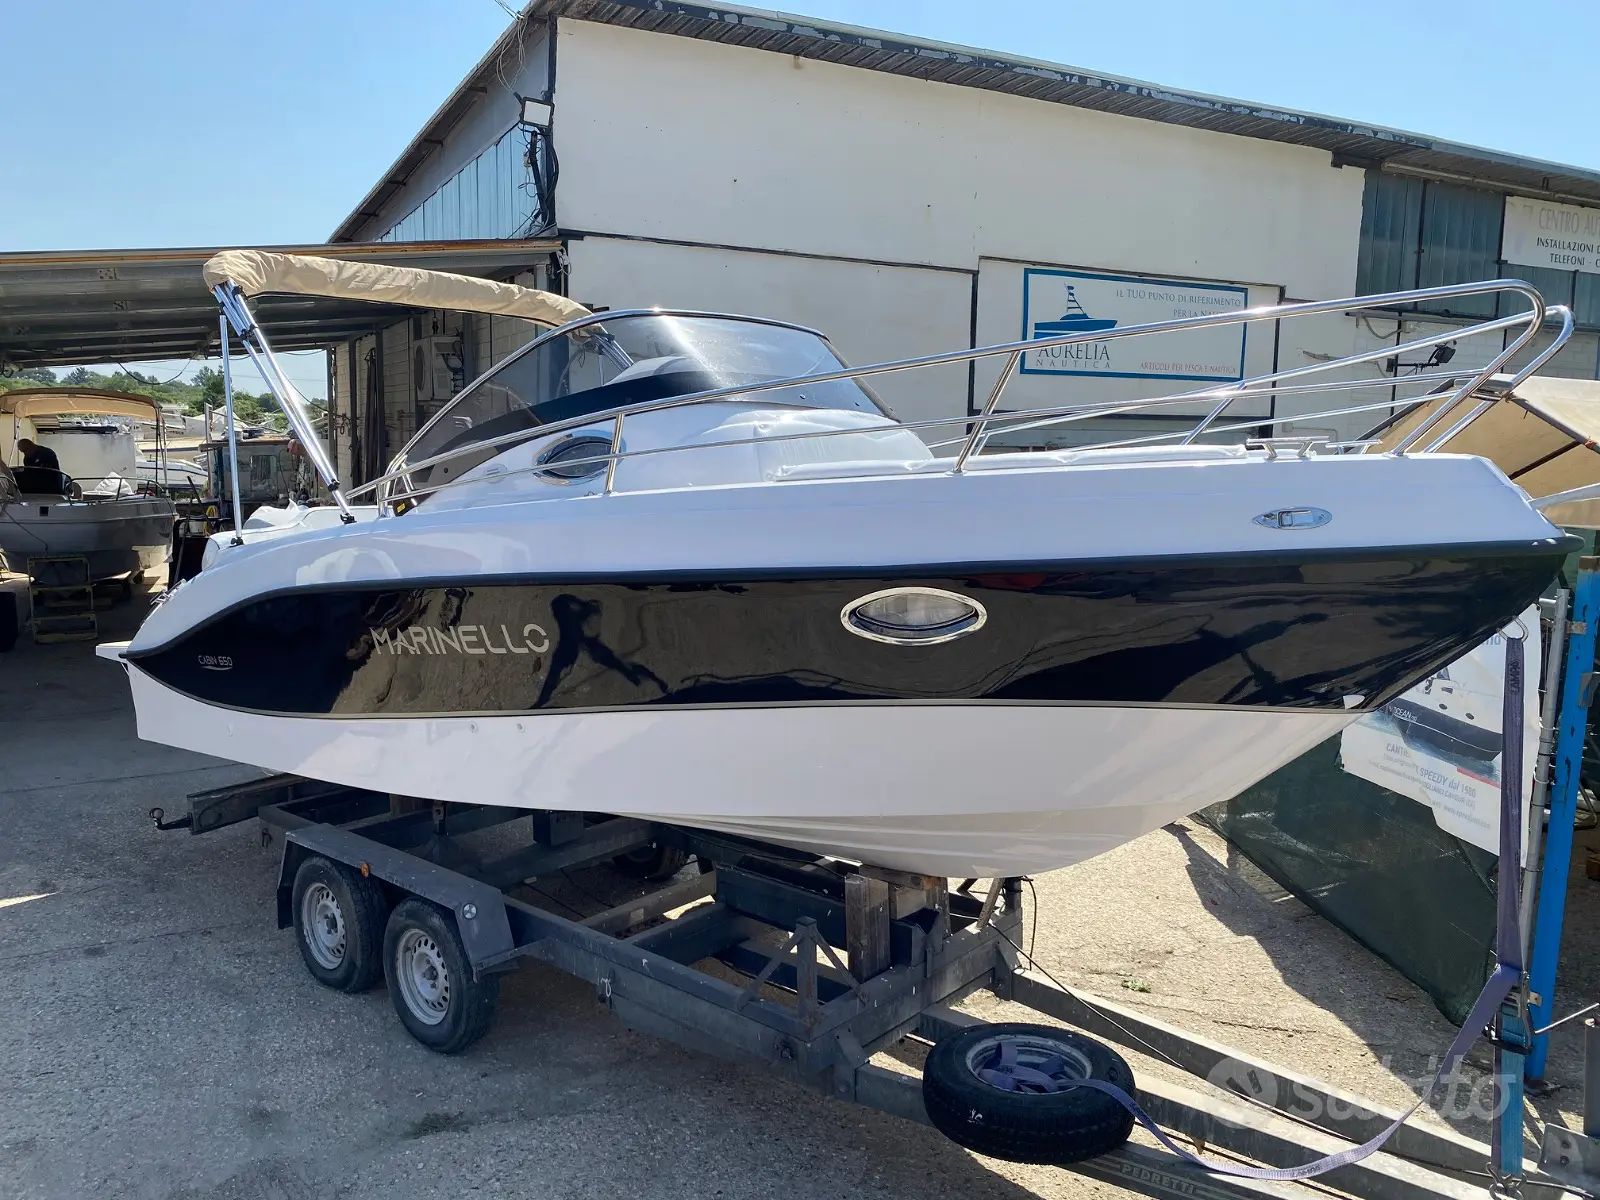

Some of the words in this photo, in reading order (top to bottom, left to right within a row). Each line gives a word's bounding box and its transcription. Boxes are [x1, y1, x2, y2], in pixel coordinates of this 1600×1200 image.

[1539, 207, 1579, 233] CENTRO
[1537, 237, 1594, 253] INSTALLAZIONI
[1550, 253, 1585, 266] TELEFONI
[1127, 289, 1145, 299] TUO
[1148, 292, 1175, 301] PUNTO
[1178, 295, 1186, 303] DI
[1189, 296, 1241, 307] RIFERIMENTO
[1174, 309, 1187, 317] PER
[1038, 343, 1110, 360] AURELIA
[1036, 359, 1111, 368] NAUTICA
[1140, 362, 1170, 371] ARTICOLI
[1185, 364, 1202, 373] PESCA
[1210, 366, 1236, 374] NAUTICA
[369, 623, 550, 655] MARINELLO
[198, 655, 217, 665] CABIN
[218, 656, 233, 666] 650
[1420, 768, 1448, 786] SPEEDY
[1448, 779, 1460, 792] dal
[1121, 1163, 1195, 1194] PEDRETTI
